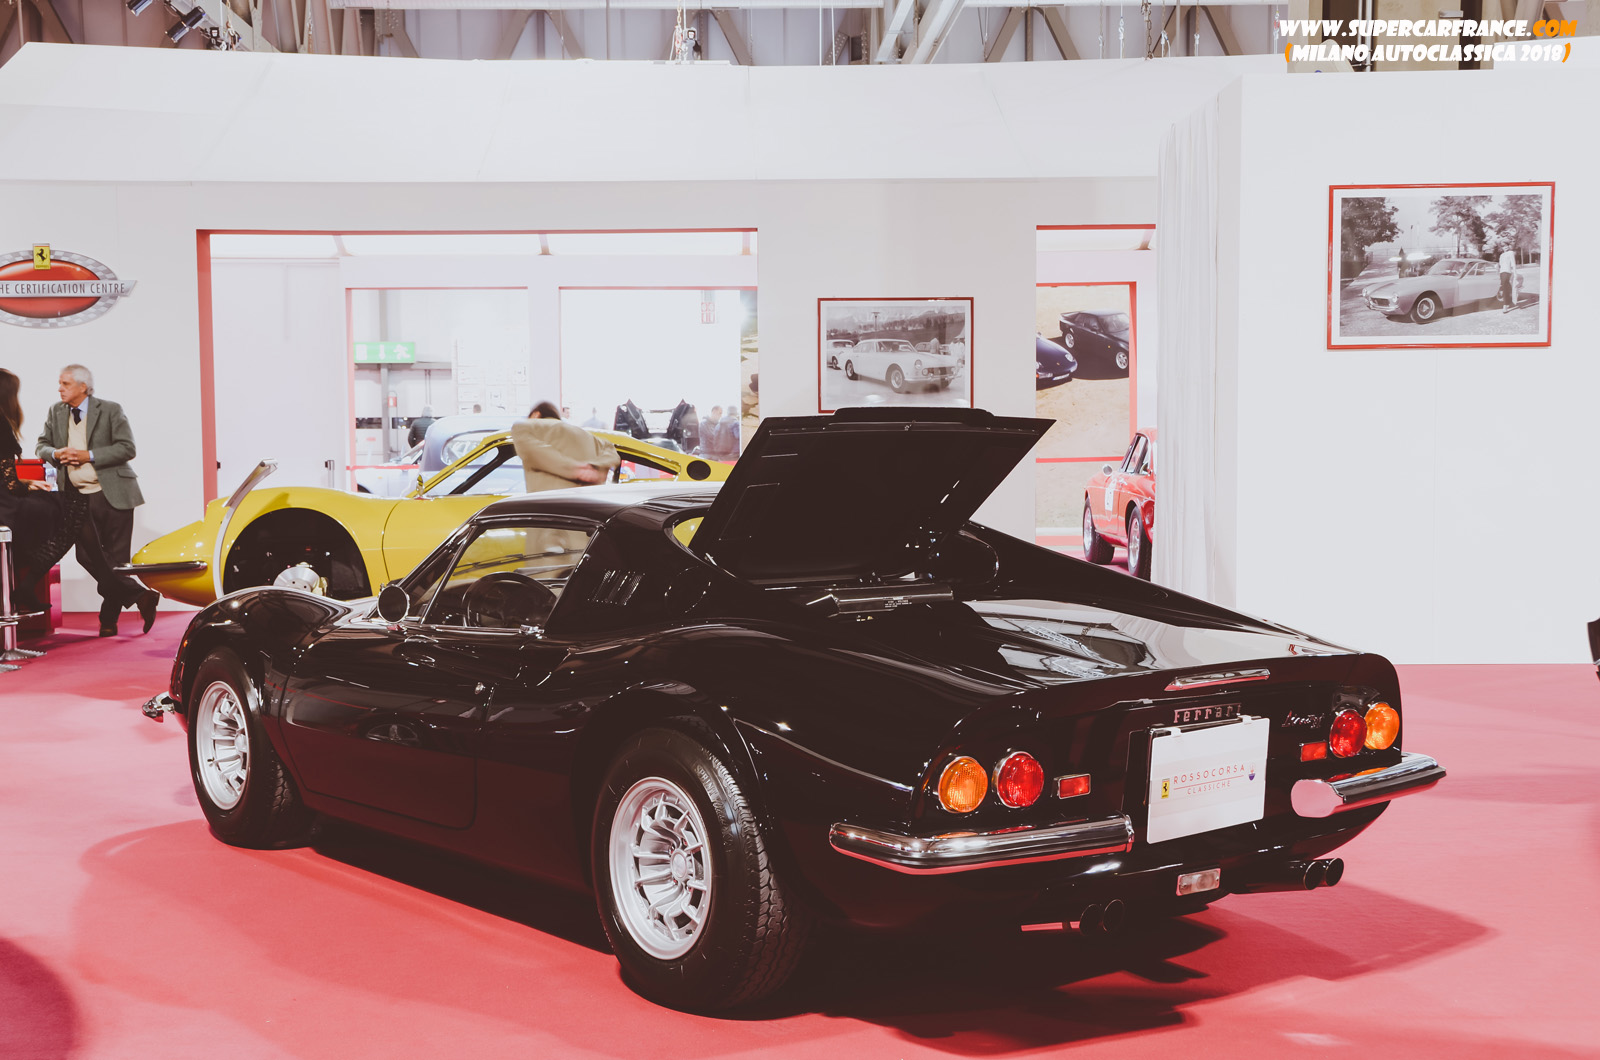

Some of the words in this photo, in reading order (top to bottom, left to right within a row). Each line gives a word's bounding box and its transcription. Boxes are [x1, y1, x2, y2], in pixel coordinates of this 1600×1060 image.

[15, 283, 85, 294] CERTIFICATION
[90, 283, 125, 294] CENTRE
[1173, 703, 1242, 723] Ferrari
[1173, 764, 1245, 784] ROSSOCORSA
[1187, 780, 1231, 795] CLASSICHE
